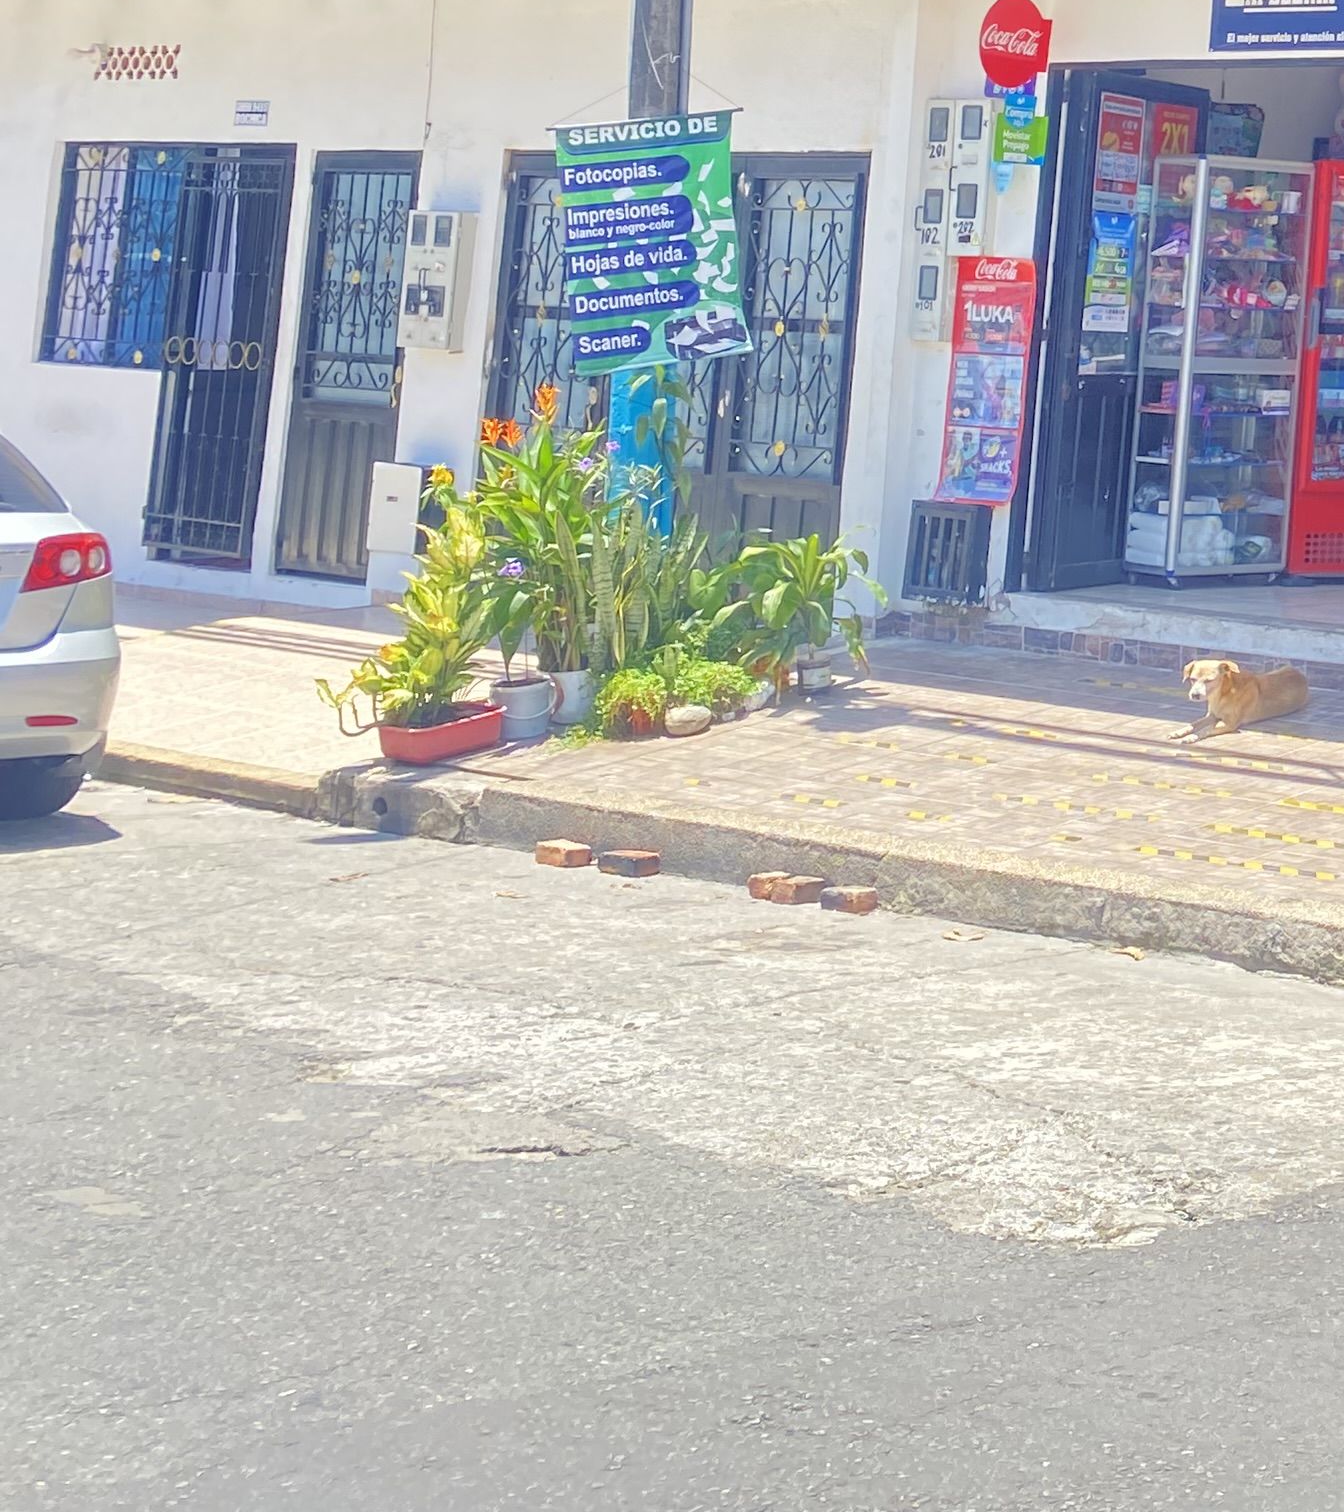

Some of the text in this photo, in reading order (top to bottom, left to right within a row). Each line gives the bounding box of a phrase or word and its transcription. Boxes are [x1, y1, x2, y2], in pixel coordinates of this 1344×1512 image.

[1237, 32, 1260, 45] mejor
[1261, 32, 1292, 43] servicio
[1293, 34, 1299, 45] y
[1300, 31, 1335, 42] atención
[568, 116, 718, 146] SERVICIO DE
[1160, 122, 1190, 154] 2X1
[564, 162, 662, 186] Fotocopias.
[567, 201, 675, 229] Impresiones.
[568, 219, 675, 240] blanco y negro-color
[571, 246, 688, 276] Hojas de vida.
[575, 287, 684, 314] Documentos.
[579, 331, 641, 355] Scaner.
